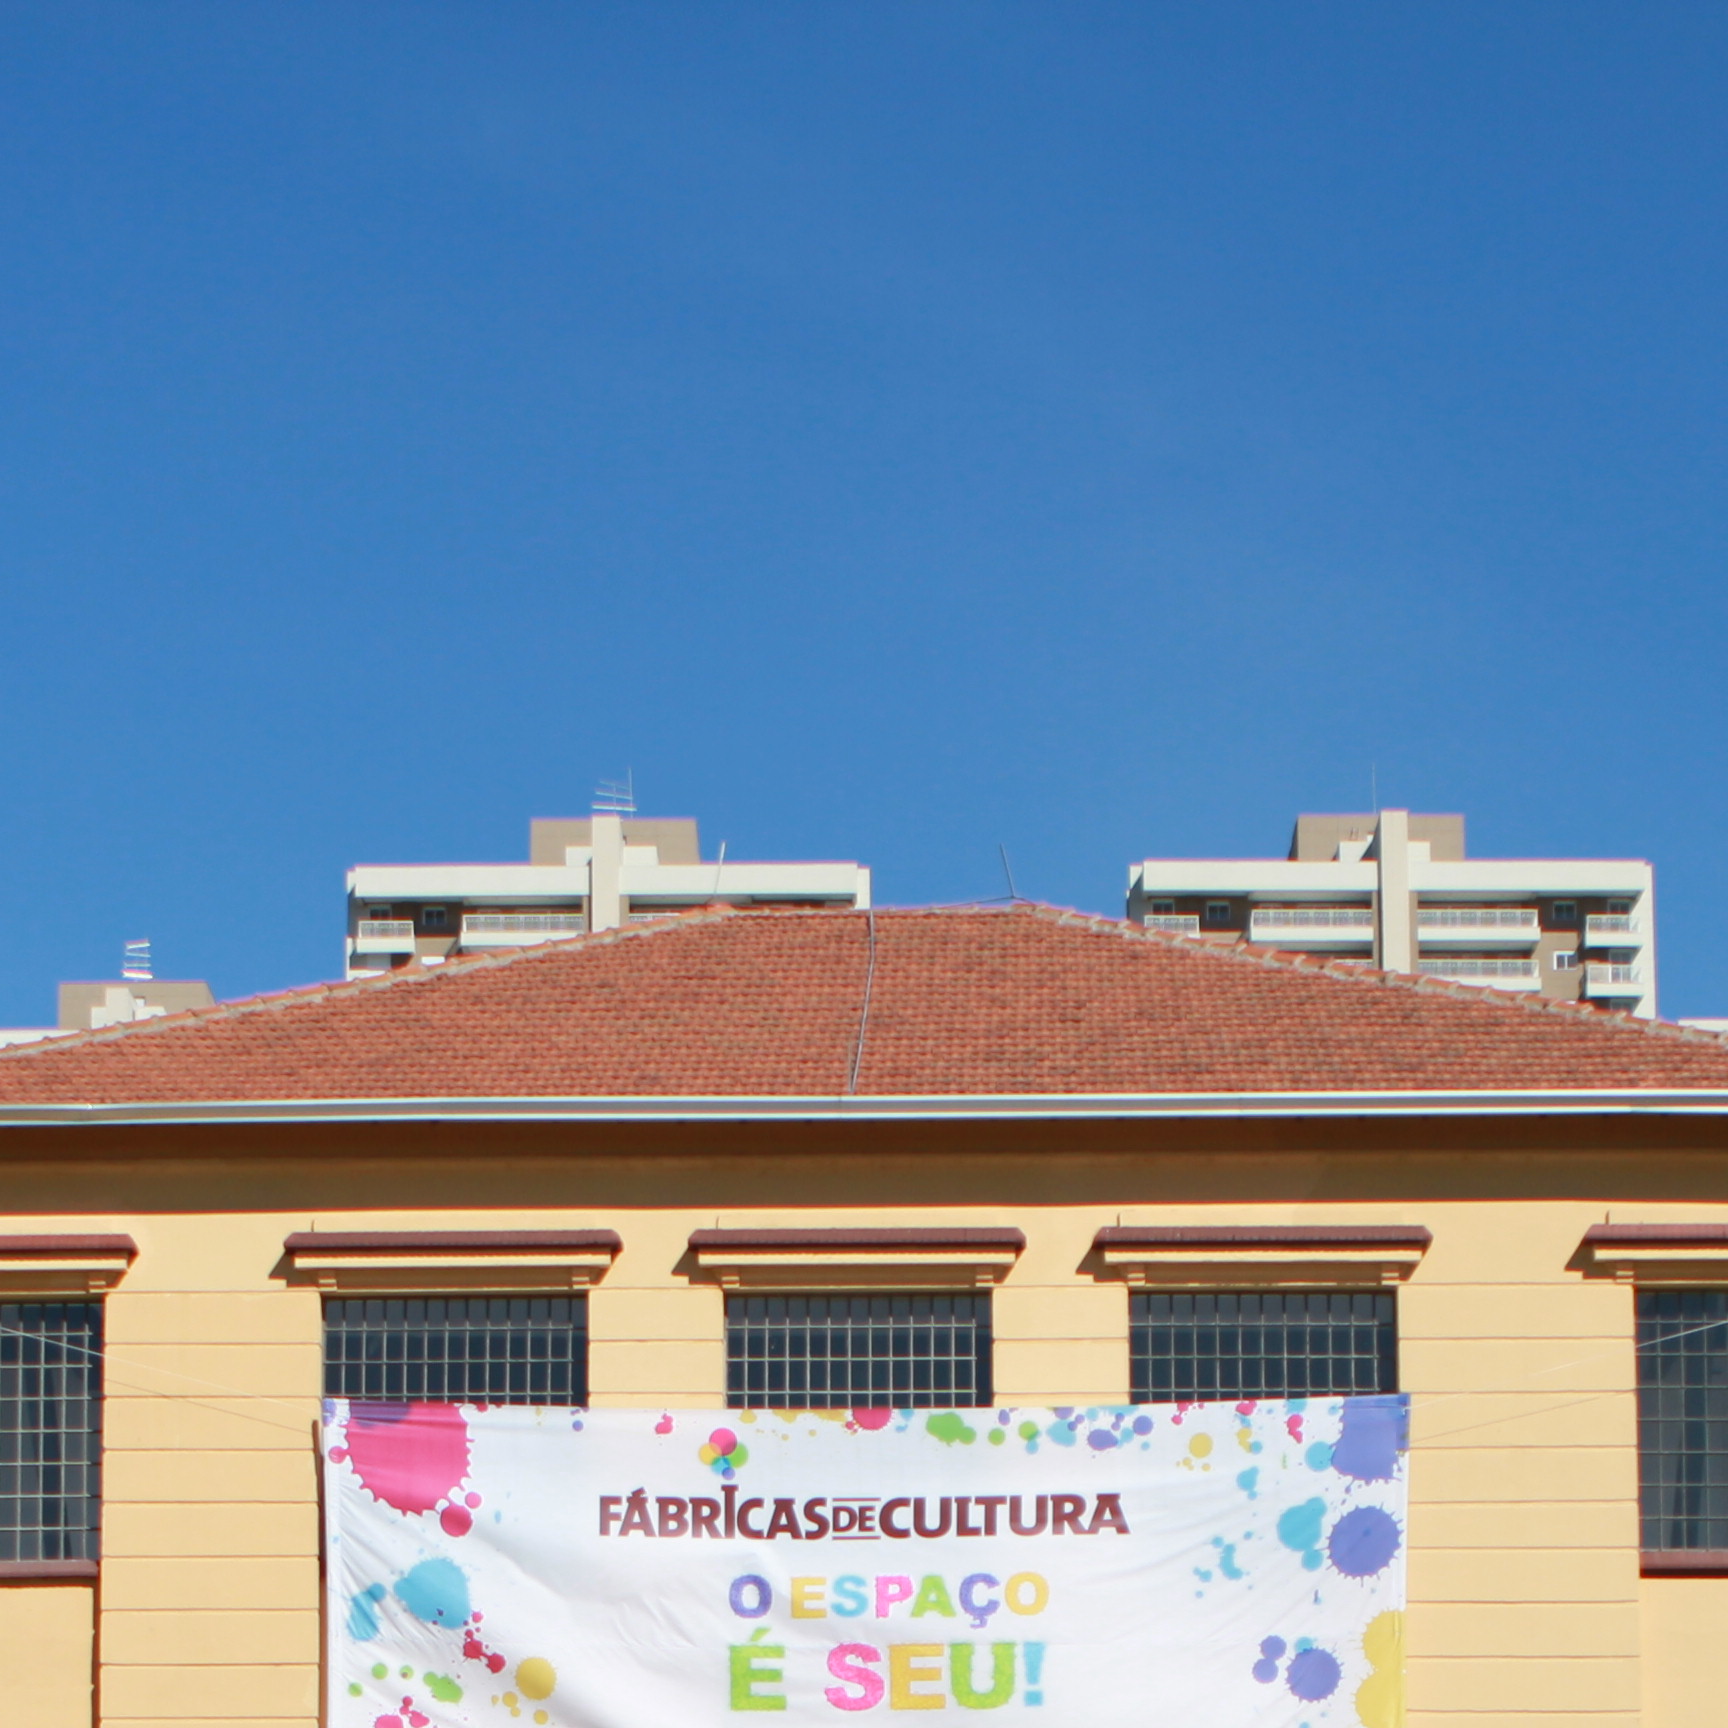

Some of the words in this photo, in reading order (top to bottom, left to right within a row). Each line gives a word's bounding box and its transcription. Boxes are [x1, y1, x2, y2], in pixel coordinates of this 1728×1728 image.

[598, 1484, 830, 1540] FÁBRICAS
[879, 1492, 1131, 1539] CULTURA
[728, 1573, 772, 1619] O
[789, 1571, 1050, 1629] ESPAÇO
[728, 1627, 787, 1711] É
[824, 1641, 1048, 1711] SEU!
